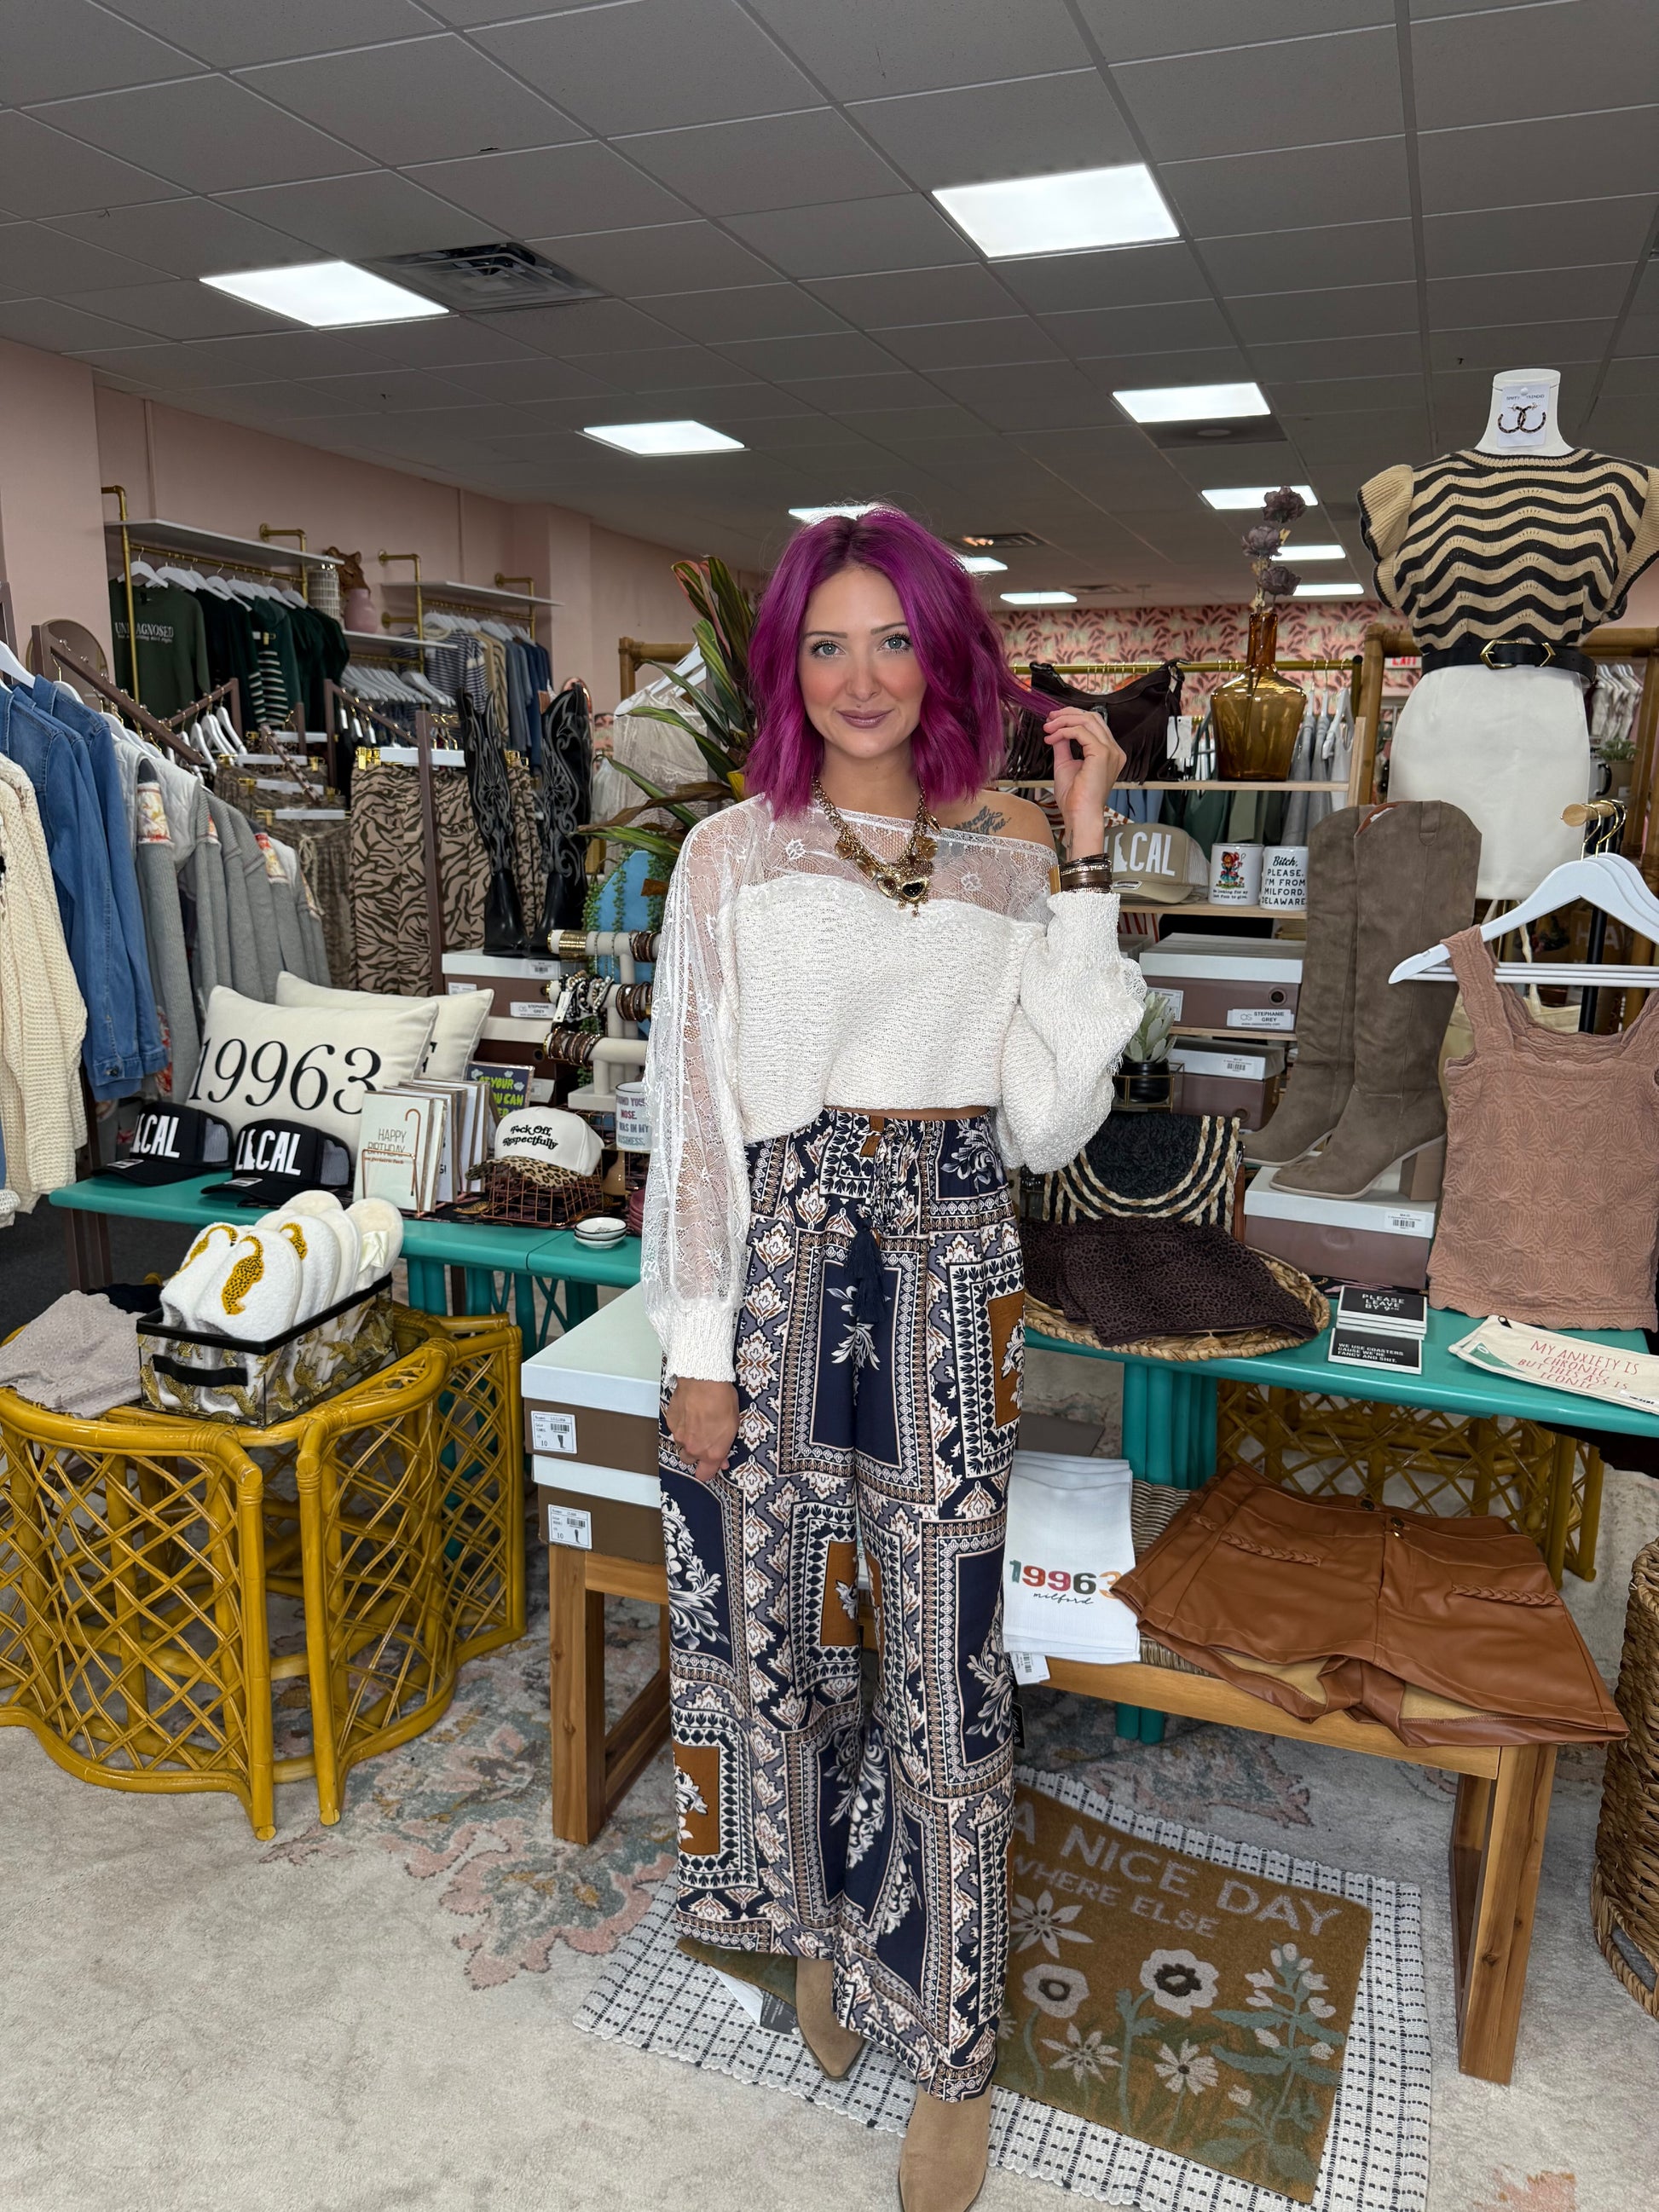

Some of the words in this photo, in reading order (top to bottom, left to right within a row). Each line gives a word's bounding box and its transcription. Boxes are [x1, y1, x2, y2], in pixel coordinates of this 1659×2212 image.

[114, 621, 174, 638] UNAGNOSED
[188, 1037, 381, 1115] 19963
[490, 1077, 514, 1089] YOUR
[503, 1093, 523, 1106] CAN
[378, 1128, 407, 1143] HAPPY
[502, 1135, 558, 1150] Respectfully
[1361, 1293, 1405, 1304] PLEASE
[1365, 1298, 1400, 1308] LEAVE
[1367, 1346, 1404, 1356] COASTERS
[1530, 1340, 1557, 1355] MY
[1558, 1349, 1621, 1369] ANXIETY
[1624, 1360, 1640, 1376] IS
[1517, 1358, 1543, 1371] BUT
[1548, 1364, 1578, 1378] THIS
[1584, 1372, 1608, 1385] ASS
[1613, 1380, 1628, 1389] IS
[1009, 1559, 1123, 1600] 19963
[1033, 1592, 1095, 1605] milford
[1060, 1823, 1198, 1898] NICE
[1217, 1878, 1343, 1937] DAY
[1130, 1894, 1221, 1939] ELSE
